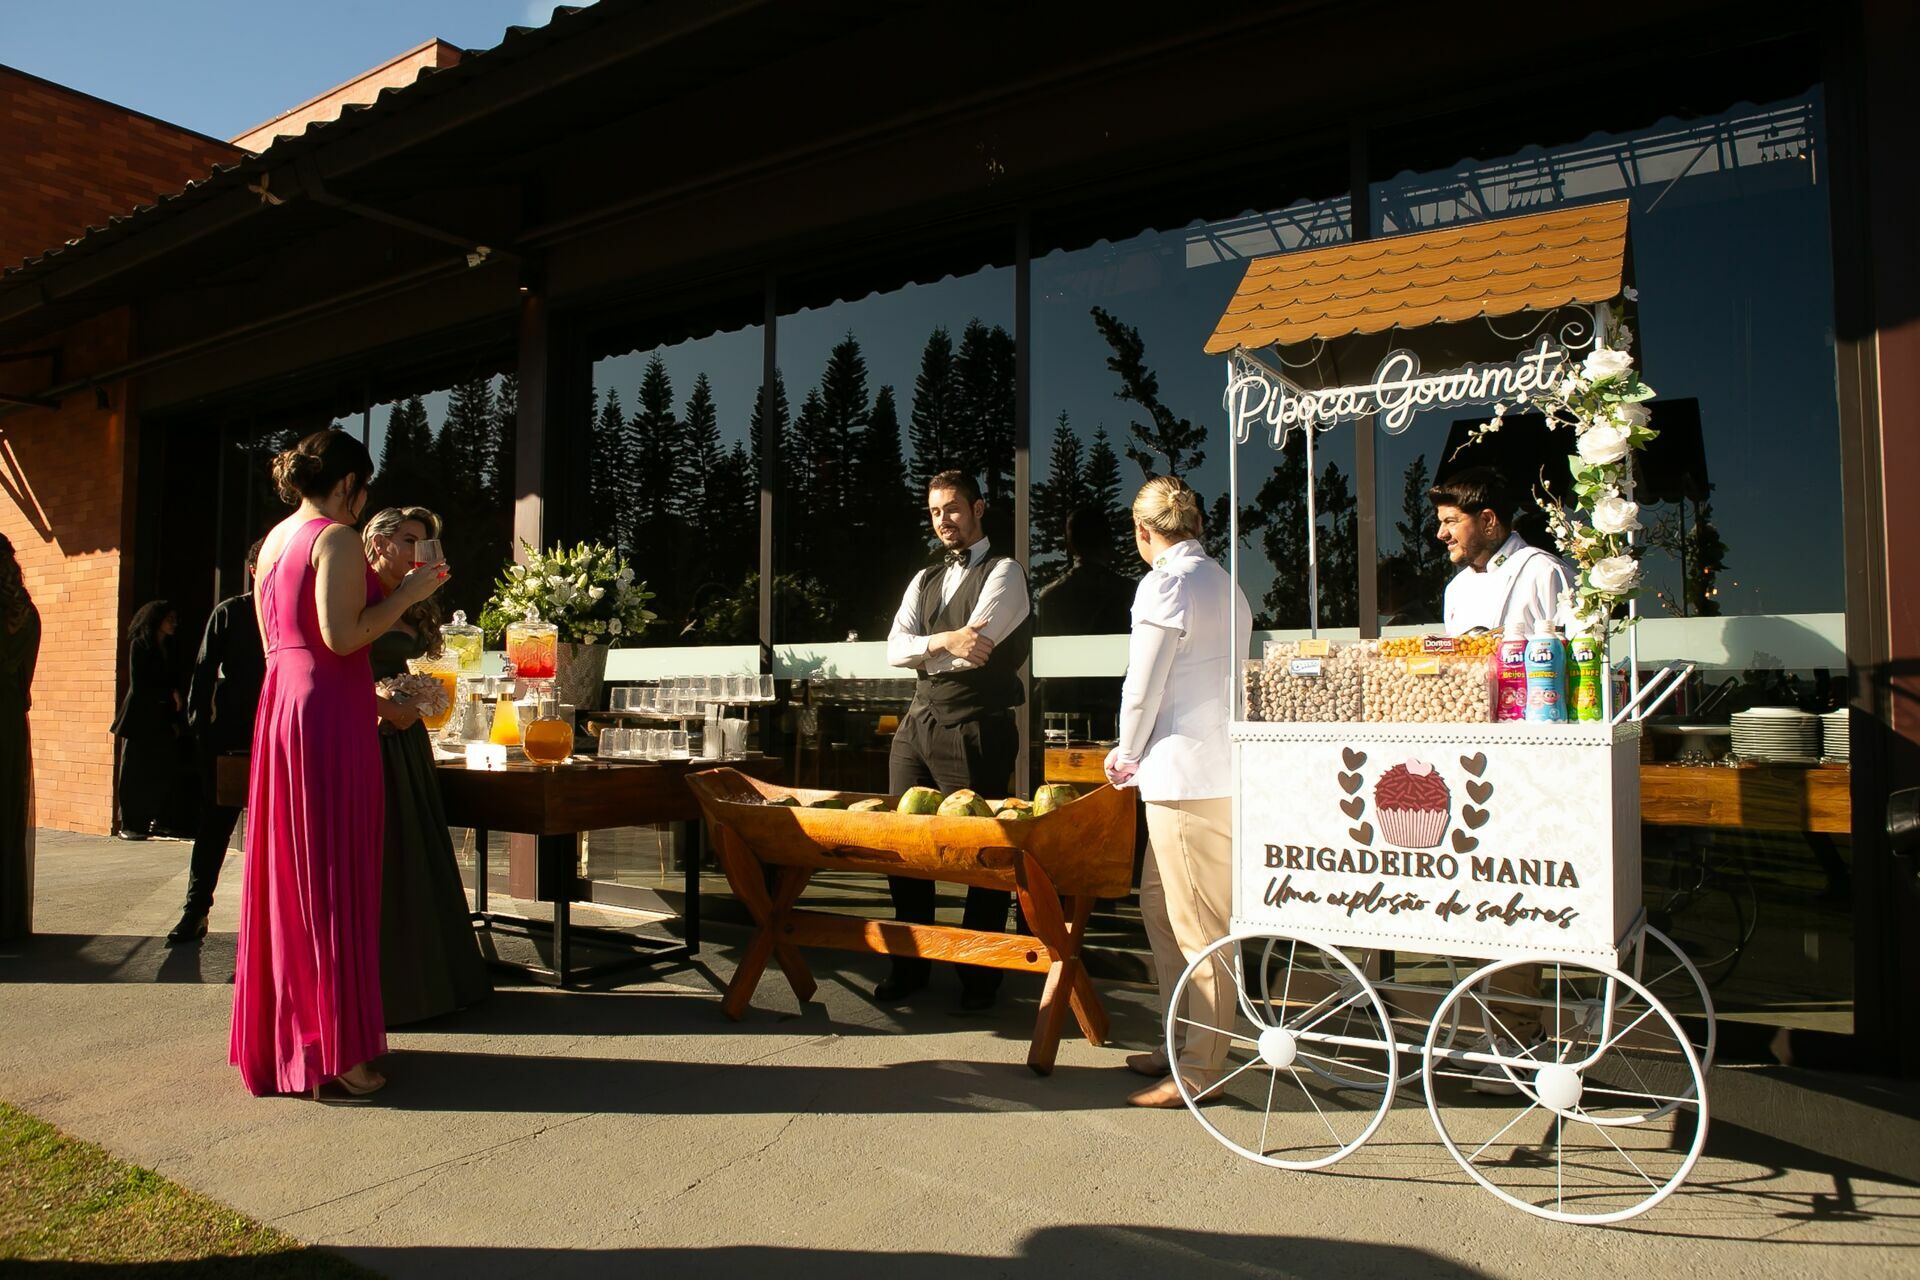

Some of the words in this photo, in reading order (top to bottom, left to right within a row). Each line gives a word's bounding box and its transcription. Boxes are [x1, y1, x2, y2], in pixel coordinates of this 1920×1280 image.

[1234, 375, 1365, 446] Pipoca
[1376, 340, 1563, 430] Gourmet
[1425, 639, 1452, 647] Doritos
[1264, 844, 1459, 880] BRIGADEIRO
[1470, 856, 1579, 888] MANIA
[1264, 875, 1322, 908] Uma
[1326, 881, 1431, 917] explosão
[1435, 889, 1471, 922] de
[1475, 892, 1580, 929] sabores
